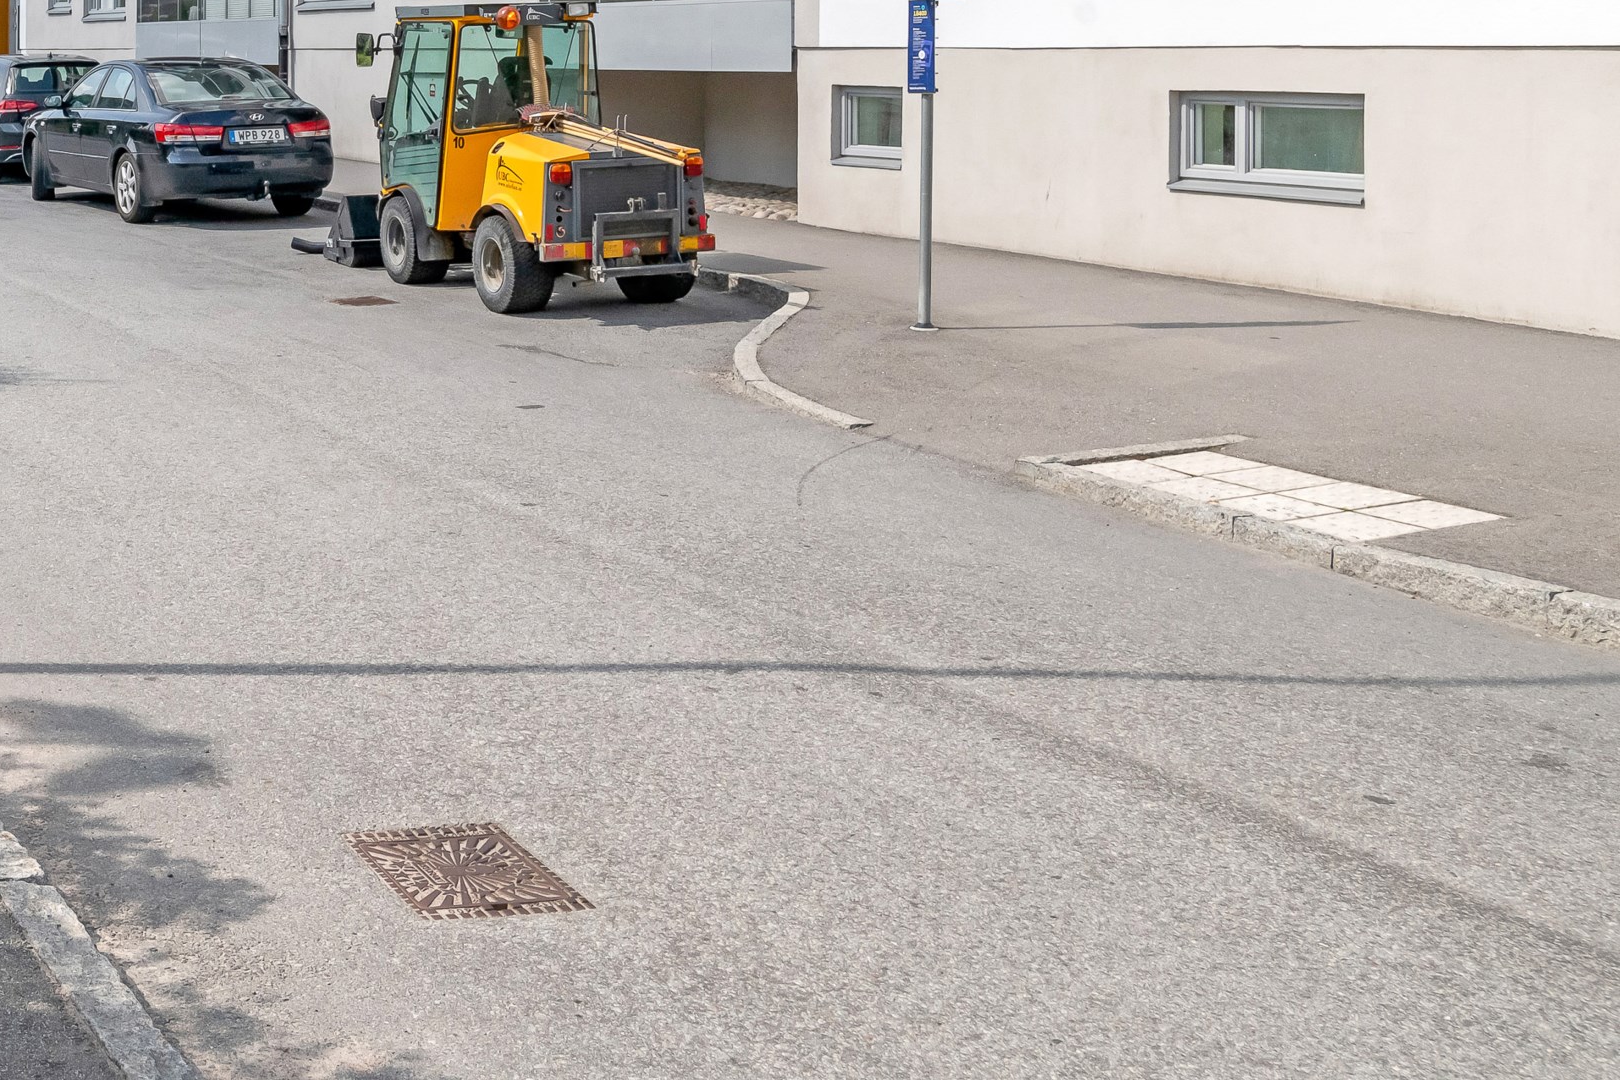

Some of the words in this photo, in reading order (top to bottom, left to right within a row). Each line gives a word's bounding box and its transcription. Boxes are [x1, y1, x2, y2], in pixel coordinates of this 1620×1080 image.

[237, 130, 258, 141] WPB
[261, 129, 281, 140] 928
[453, 136, 465, 149] 10
